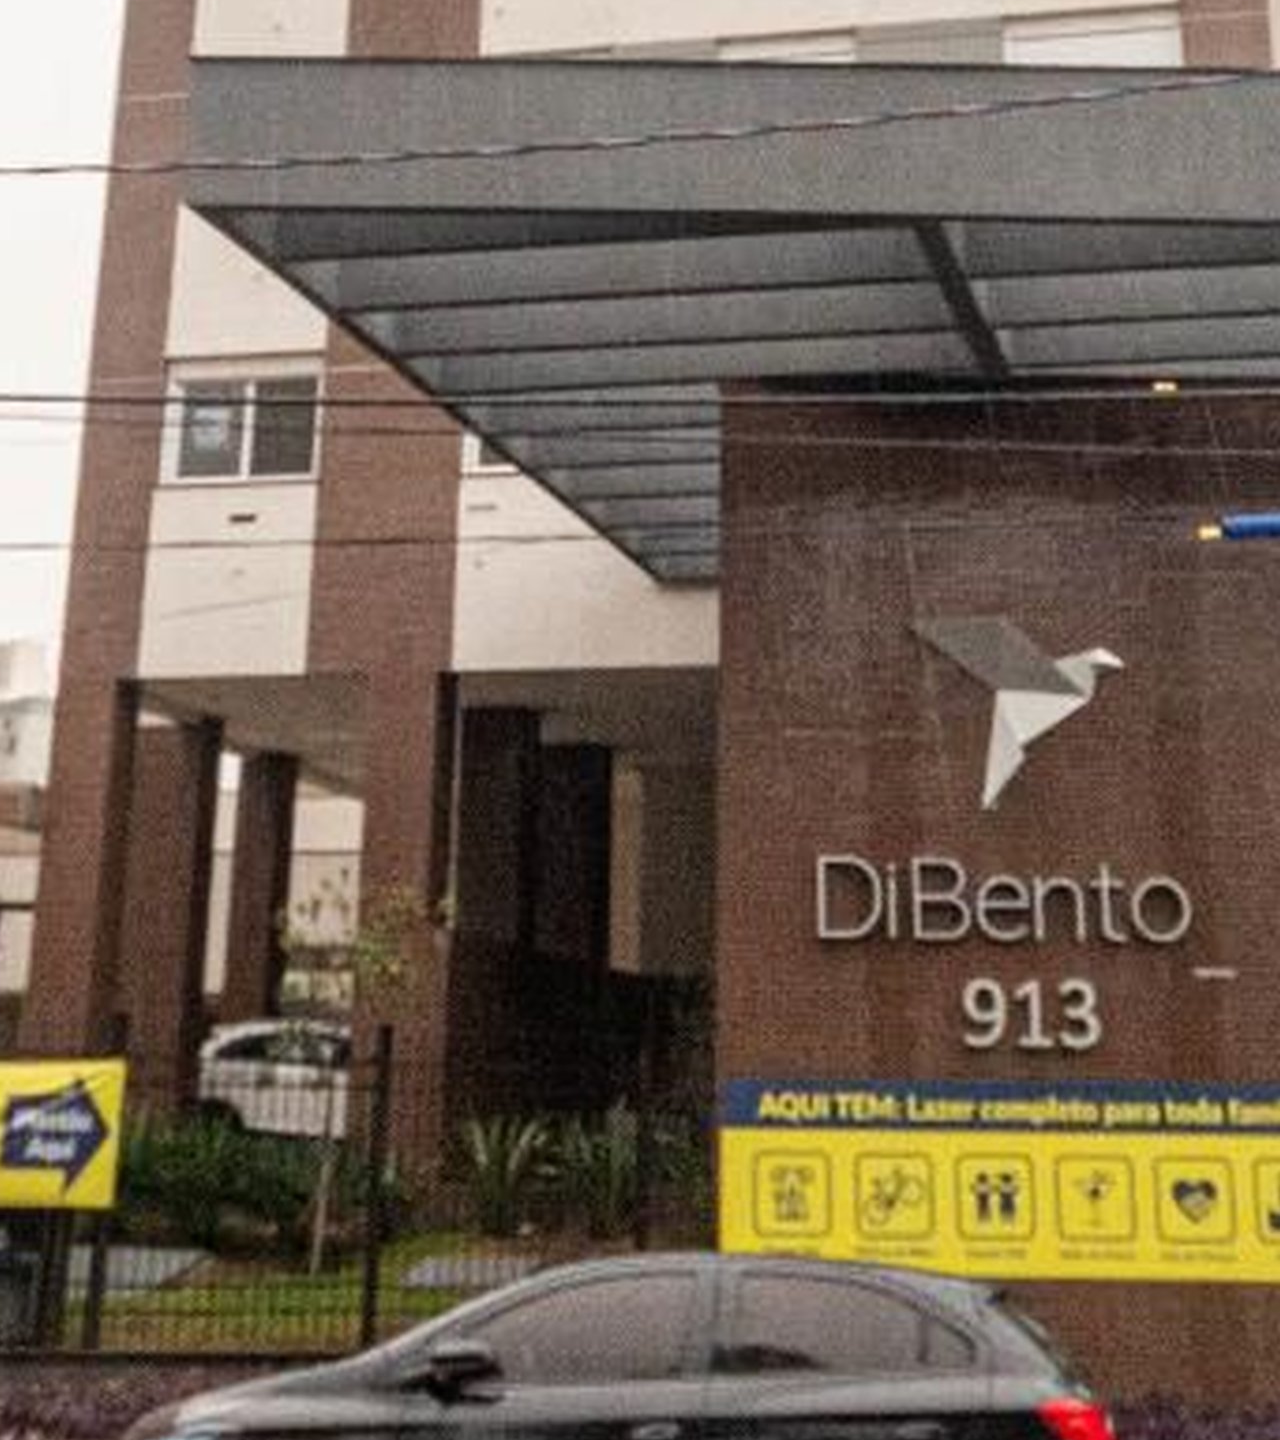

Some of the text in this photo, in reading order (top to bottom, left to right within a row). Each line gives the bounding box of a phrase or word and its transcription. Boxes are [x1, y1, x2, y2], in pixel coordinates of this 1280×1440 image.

[817, 852, 1193, 943] DiBento
[960, 976, 1103, 1050] 913
[759, 1091, 828, 1120] AQUI
